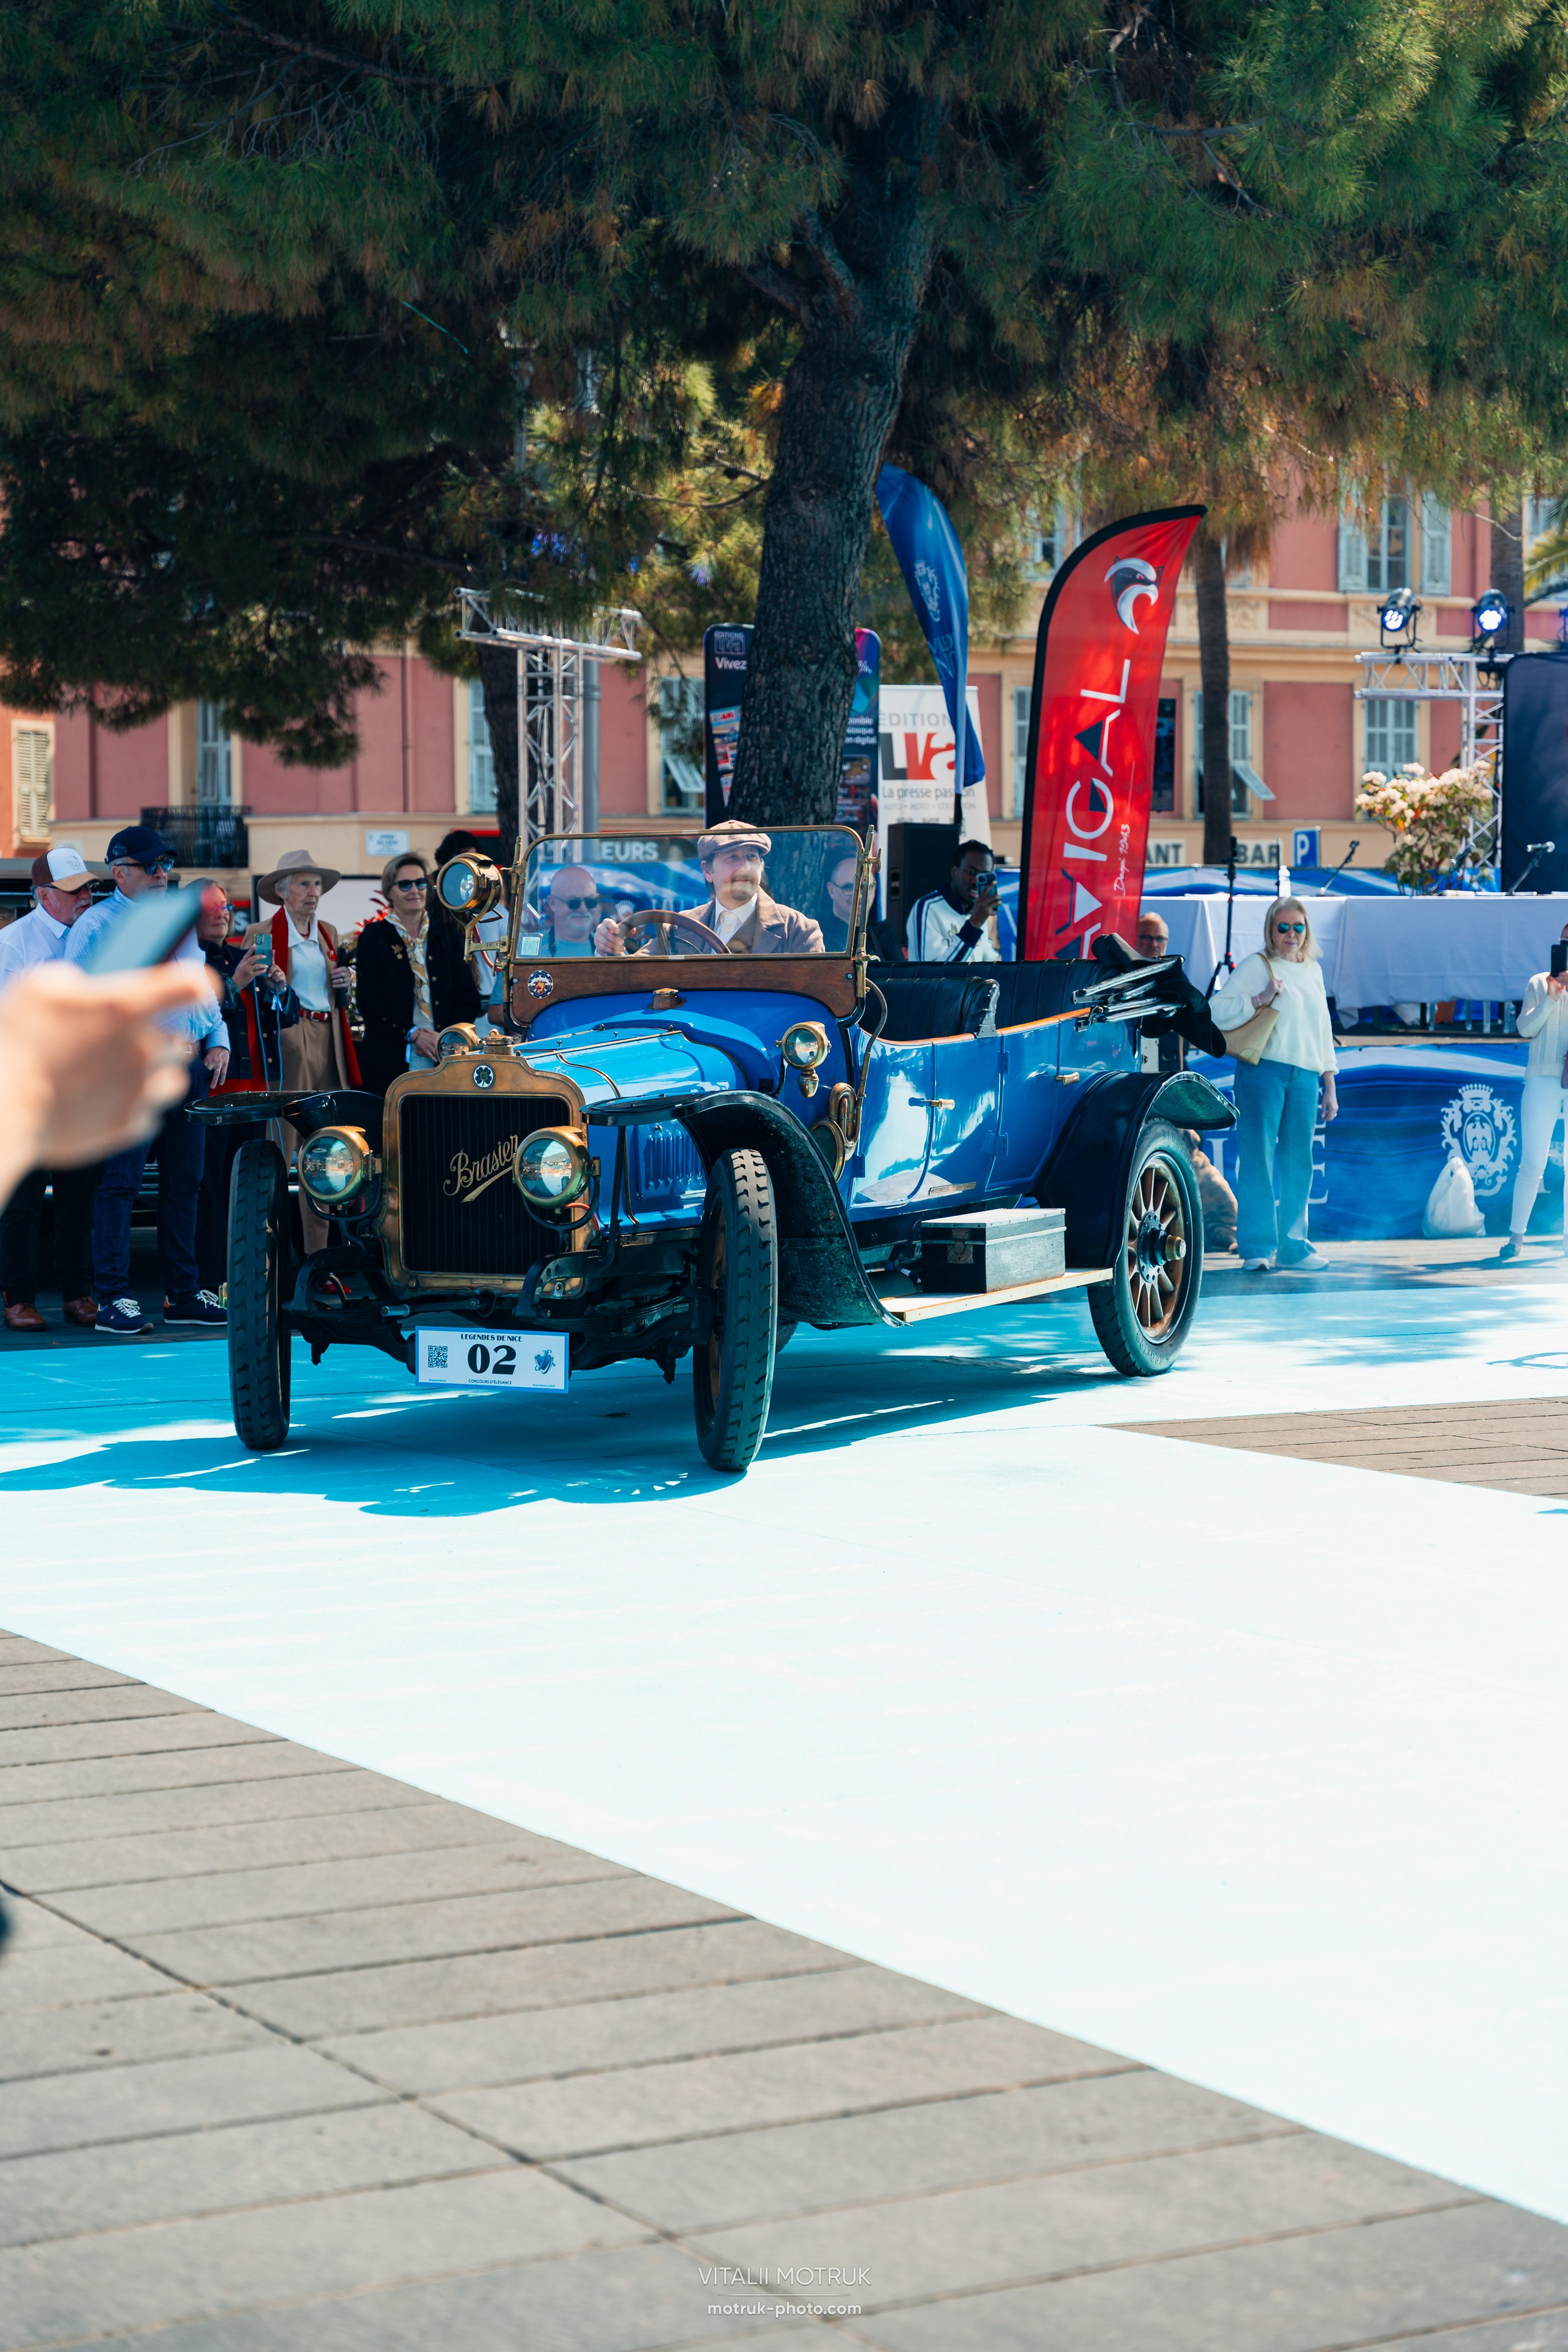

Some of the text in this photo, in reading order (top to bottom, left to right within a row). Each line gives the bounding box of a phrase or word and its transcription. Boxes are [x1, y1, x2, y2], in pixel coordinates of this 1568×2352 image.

[715, 657, 748, 670] Vivez
[879, 709, 952, 726] ÉDITION
[882, 786, 976, 801] La presse pason
[1118, 824, 1130, 854] 1943
[1296, 834, 1310, 865] P
[1237, 843, 1278, 863] BAR
[443, 1134, 518, 1196] Brasier
[467, 1343, 517, 1375] 02
